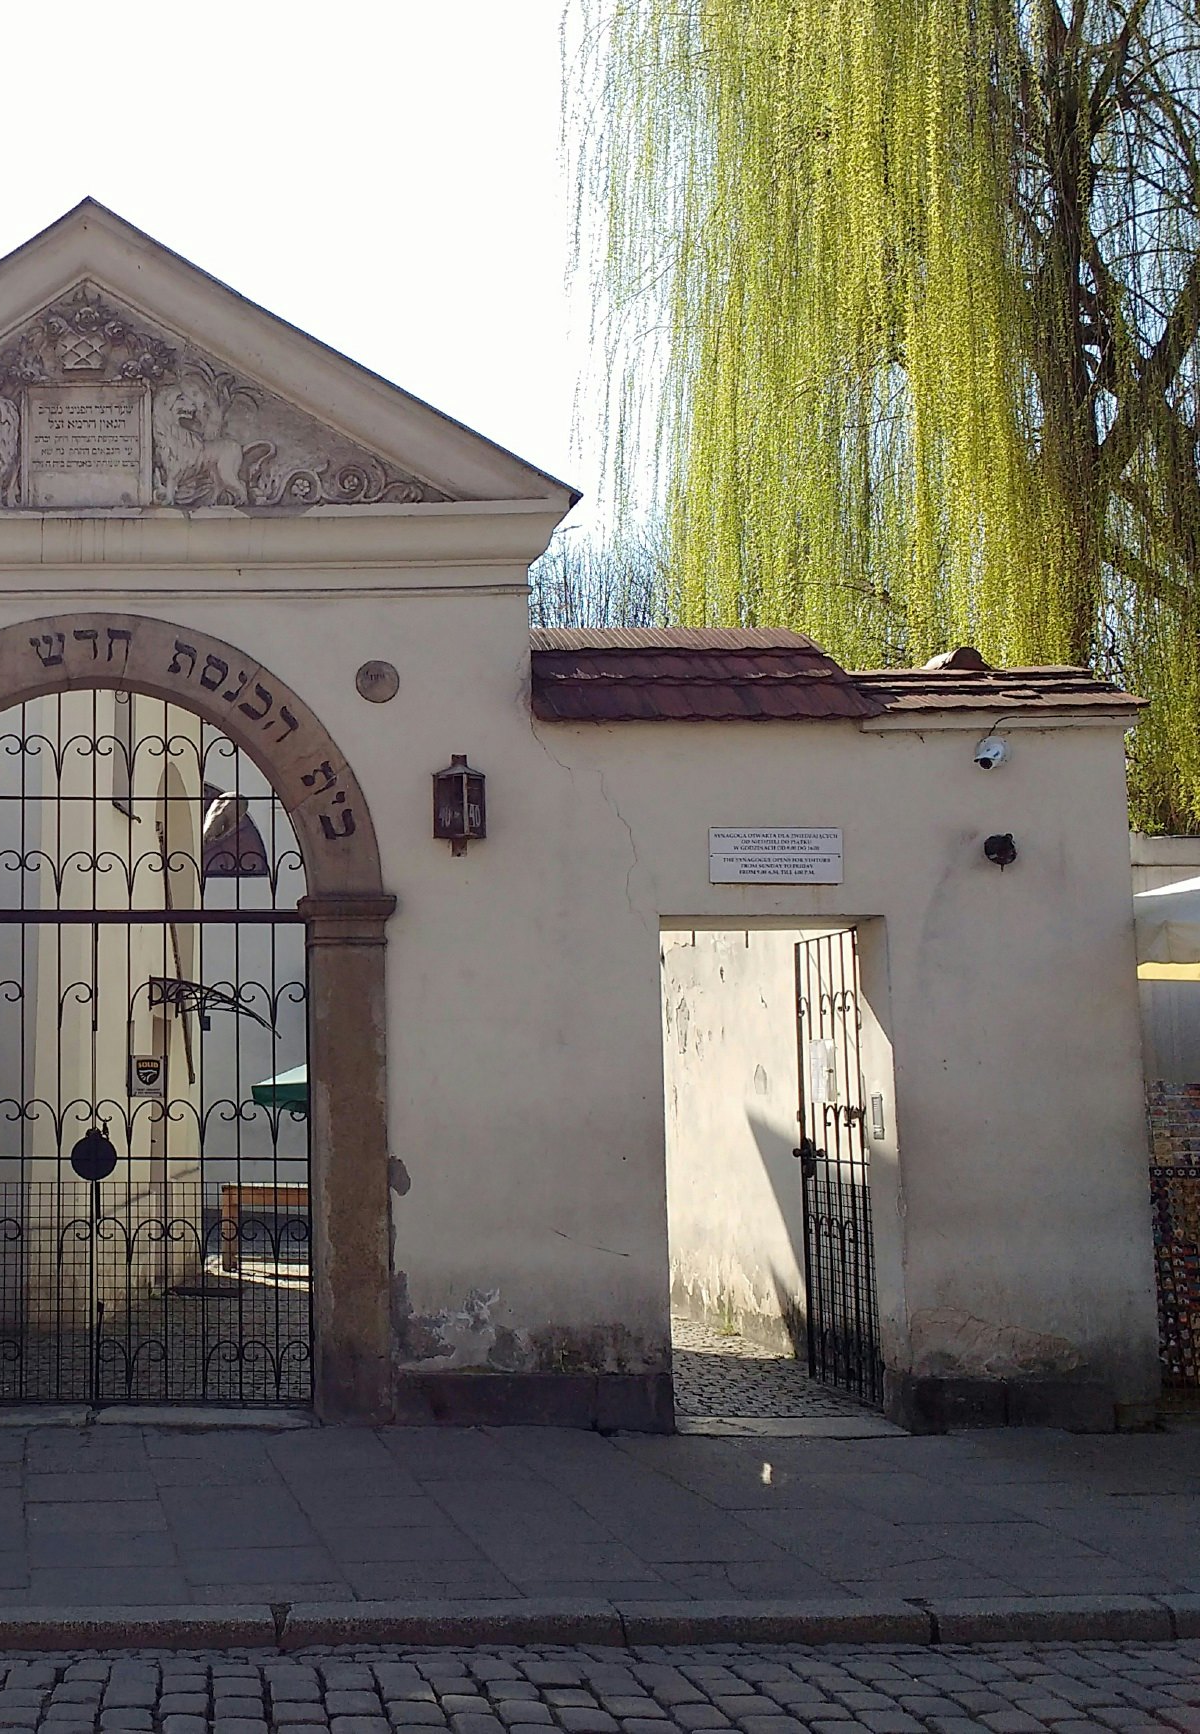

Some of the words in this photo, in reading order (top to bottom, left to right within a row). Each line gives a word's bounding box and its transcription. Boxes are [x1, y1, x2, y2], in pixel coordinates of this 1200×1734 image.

[29, 627, 132, 667] חדש
[168, 639, 299, 742] הכנסת
[301, 760, 356, 840] בית
